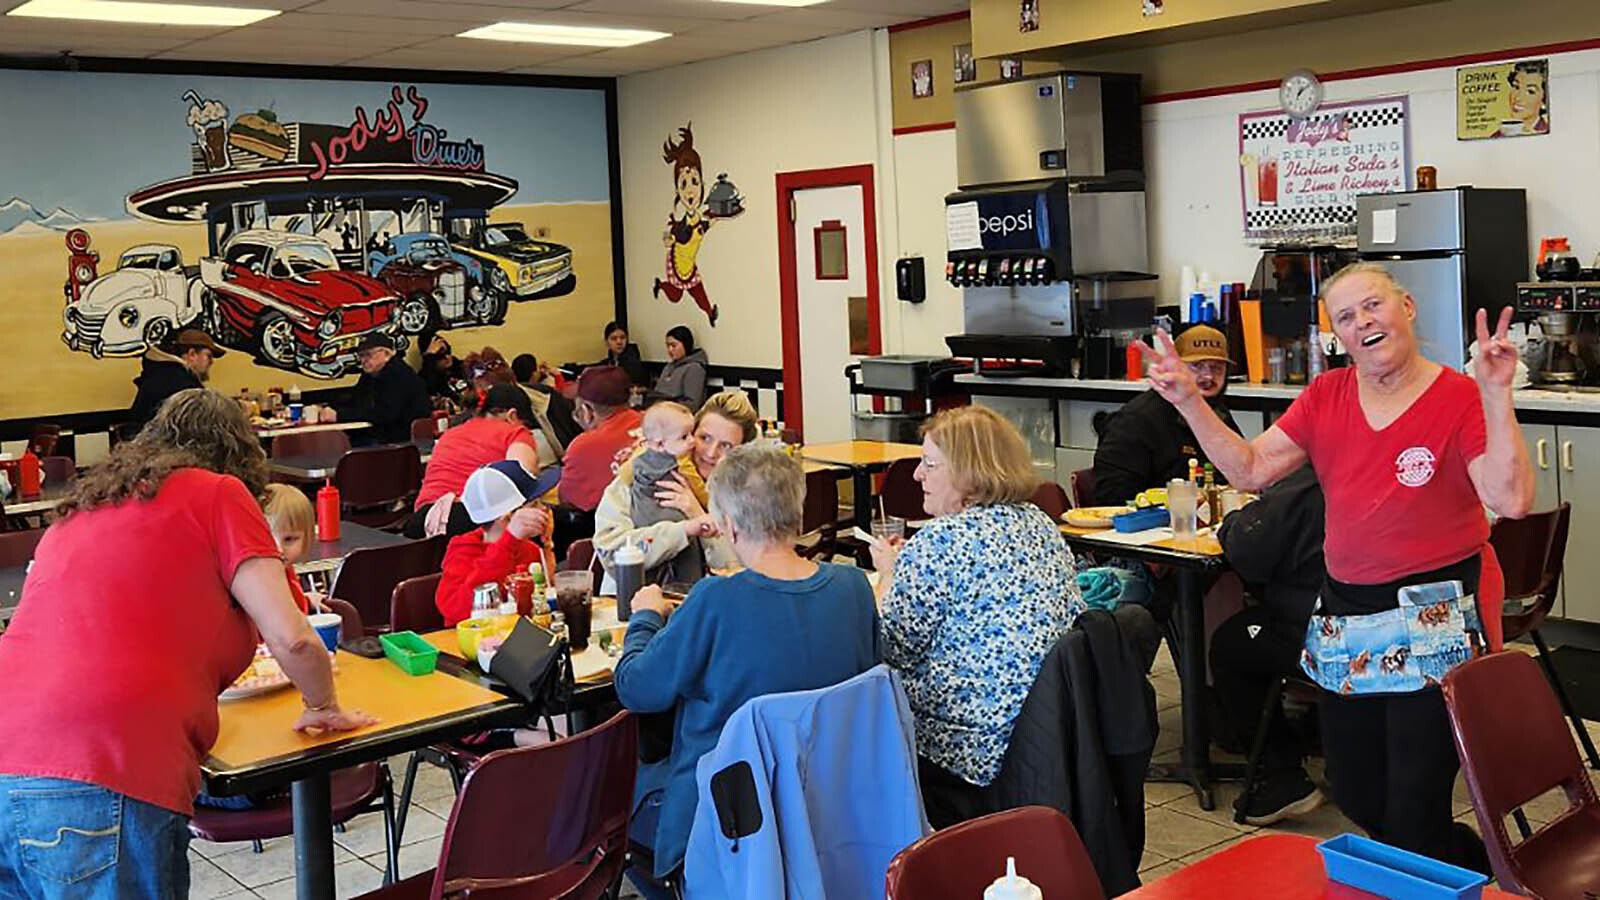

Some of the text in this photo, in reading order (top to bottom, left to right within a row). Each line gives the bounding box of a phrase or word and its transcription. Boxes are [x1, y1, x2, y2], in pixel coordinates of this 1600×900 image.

[1465, 72, 1497, 83] DRINK
[1462, 82, 1500, 94] COFFEE
[308, 84, 428, 181] Jody's
[406, 123, 484, 170] Diner
[1284, 159, 1339, 178] Italian
[1299, 178, 1335, 193] Lime
